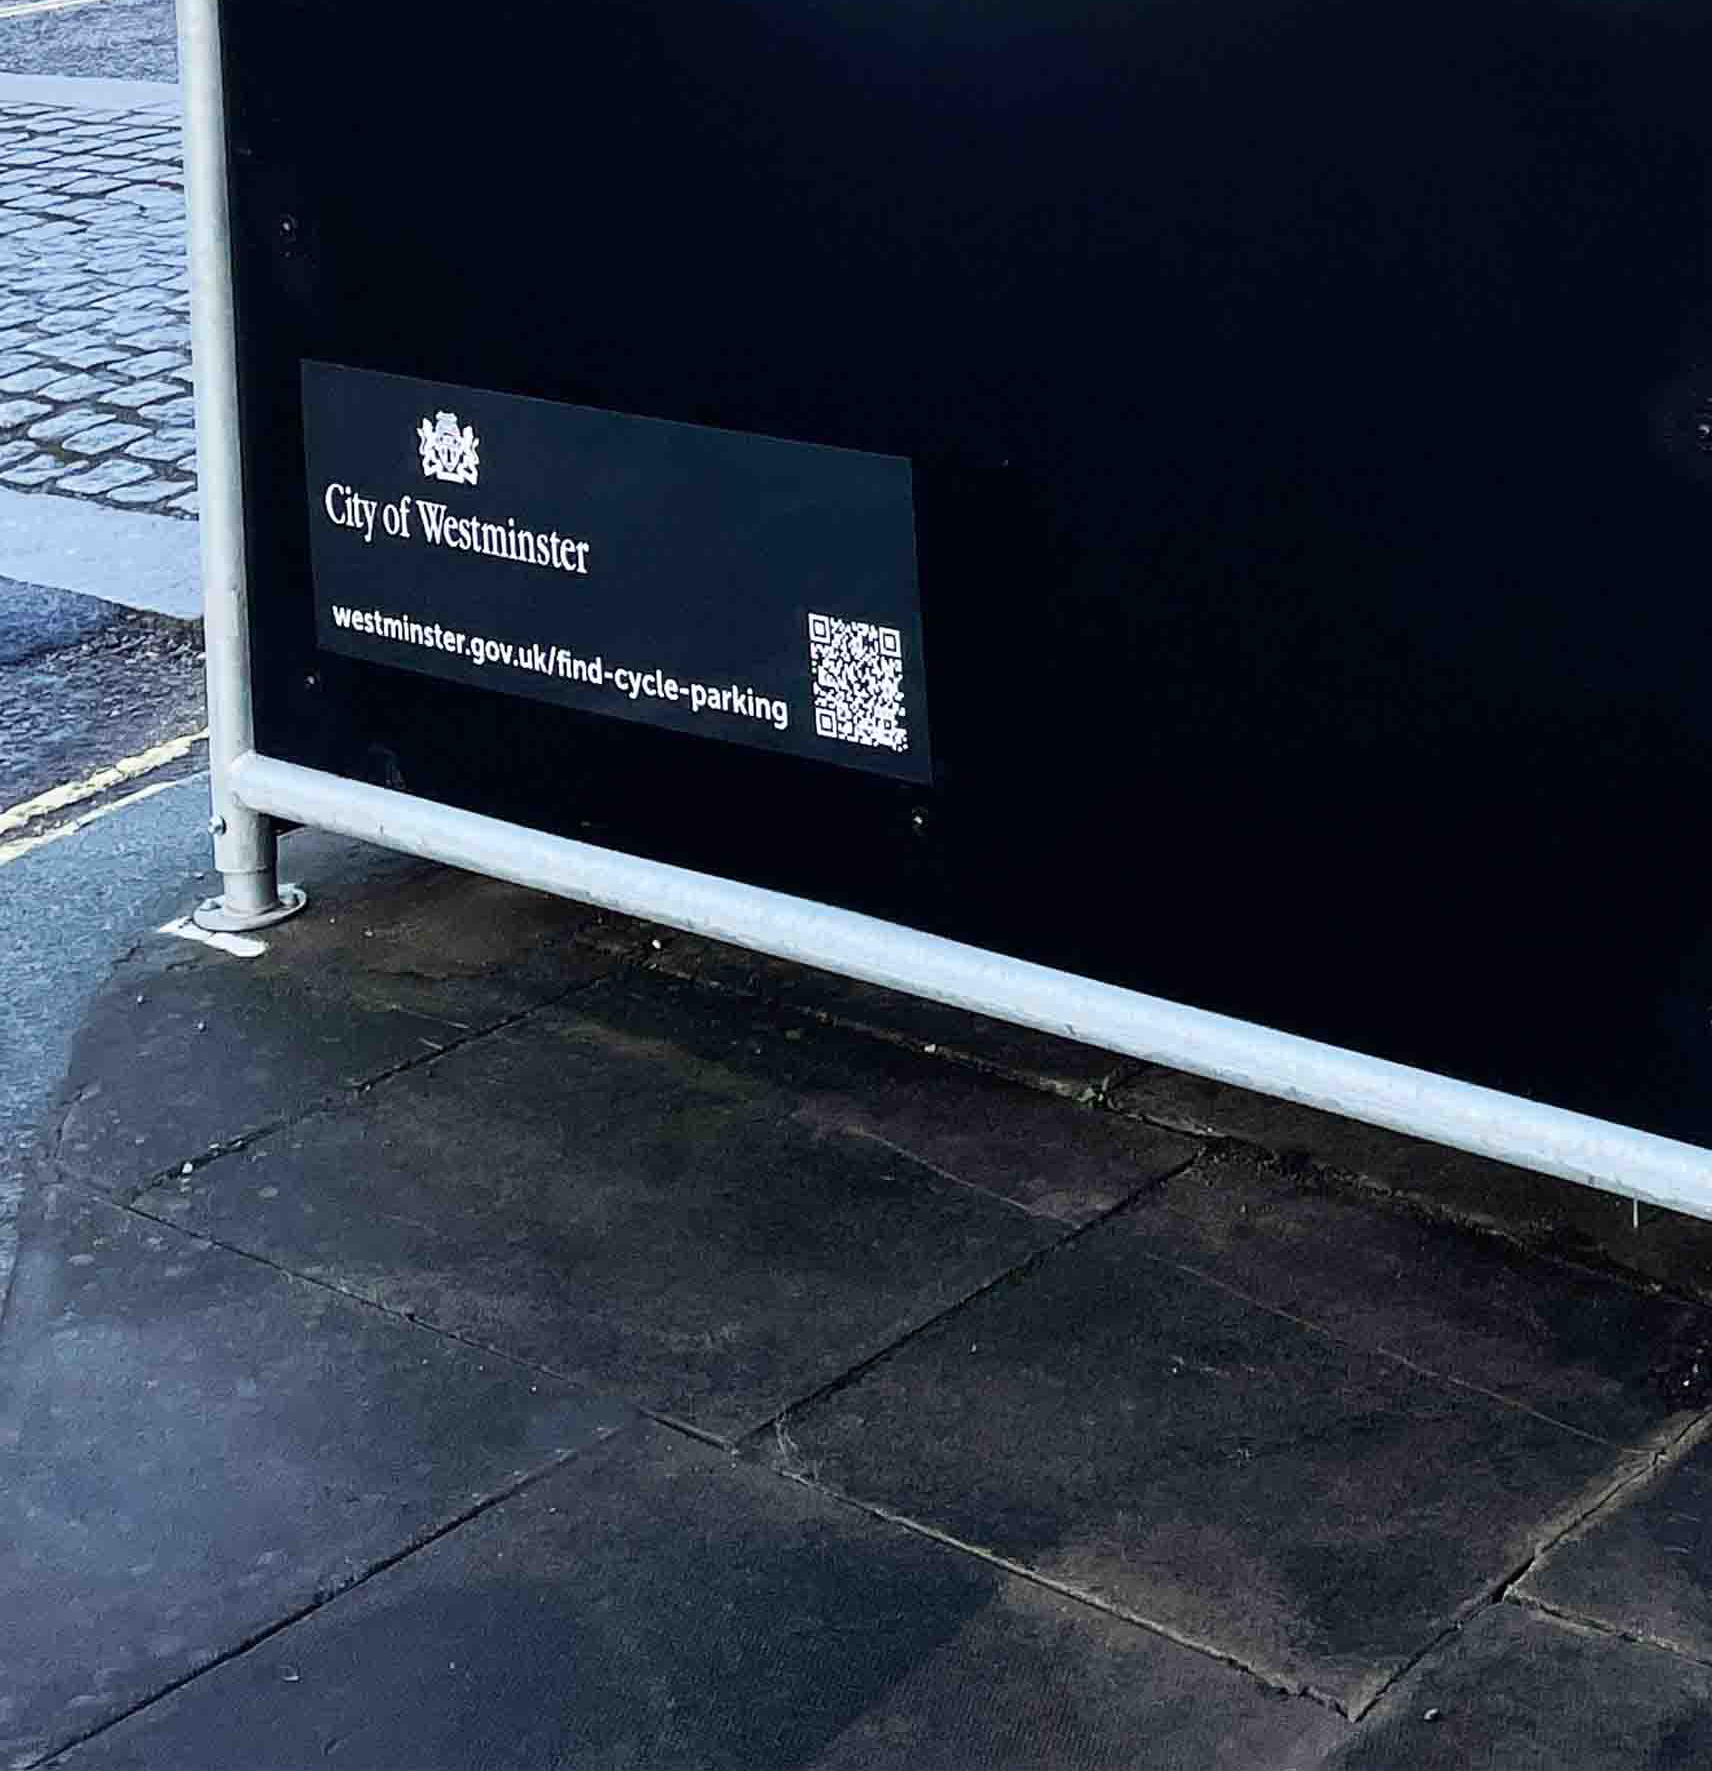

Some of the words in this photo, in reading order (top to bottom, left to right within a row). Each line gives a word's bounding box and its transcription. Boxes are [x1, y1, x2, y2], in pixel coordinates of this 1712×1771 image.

[325, 483, 377, 543] City
[383, 494, 412, 538] of
[416, 499, 591, 575] Westminster
[331, 602, 789, 731] westminster.gov.uk/find-cycle-parking
